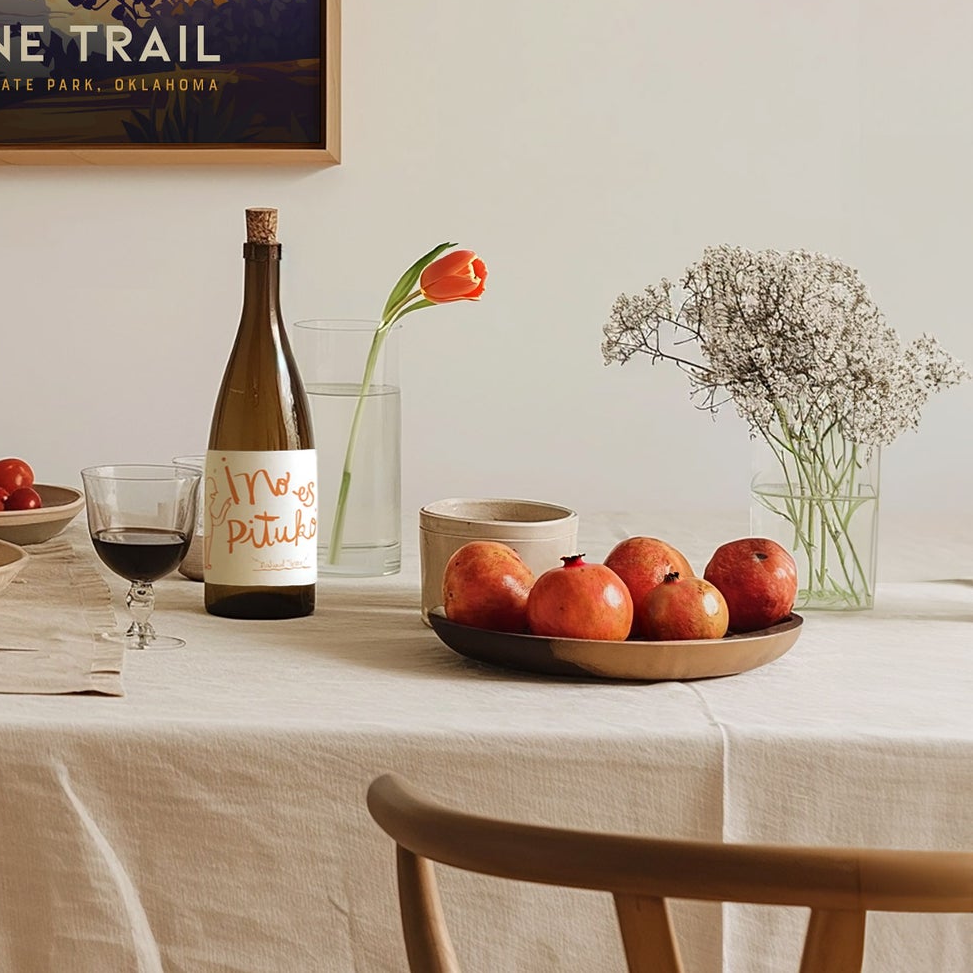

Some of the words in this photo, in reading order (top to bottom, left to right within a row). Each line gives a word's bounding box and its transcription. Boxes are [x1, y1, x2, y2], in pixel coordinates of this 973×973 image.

[69, 25, 221, 62] TRAIL
[47, 78, 102, 93] PARK,
[114, 78, 218, 91] OKLAHOMA
[292, 481, 315, 507] es
